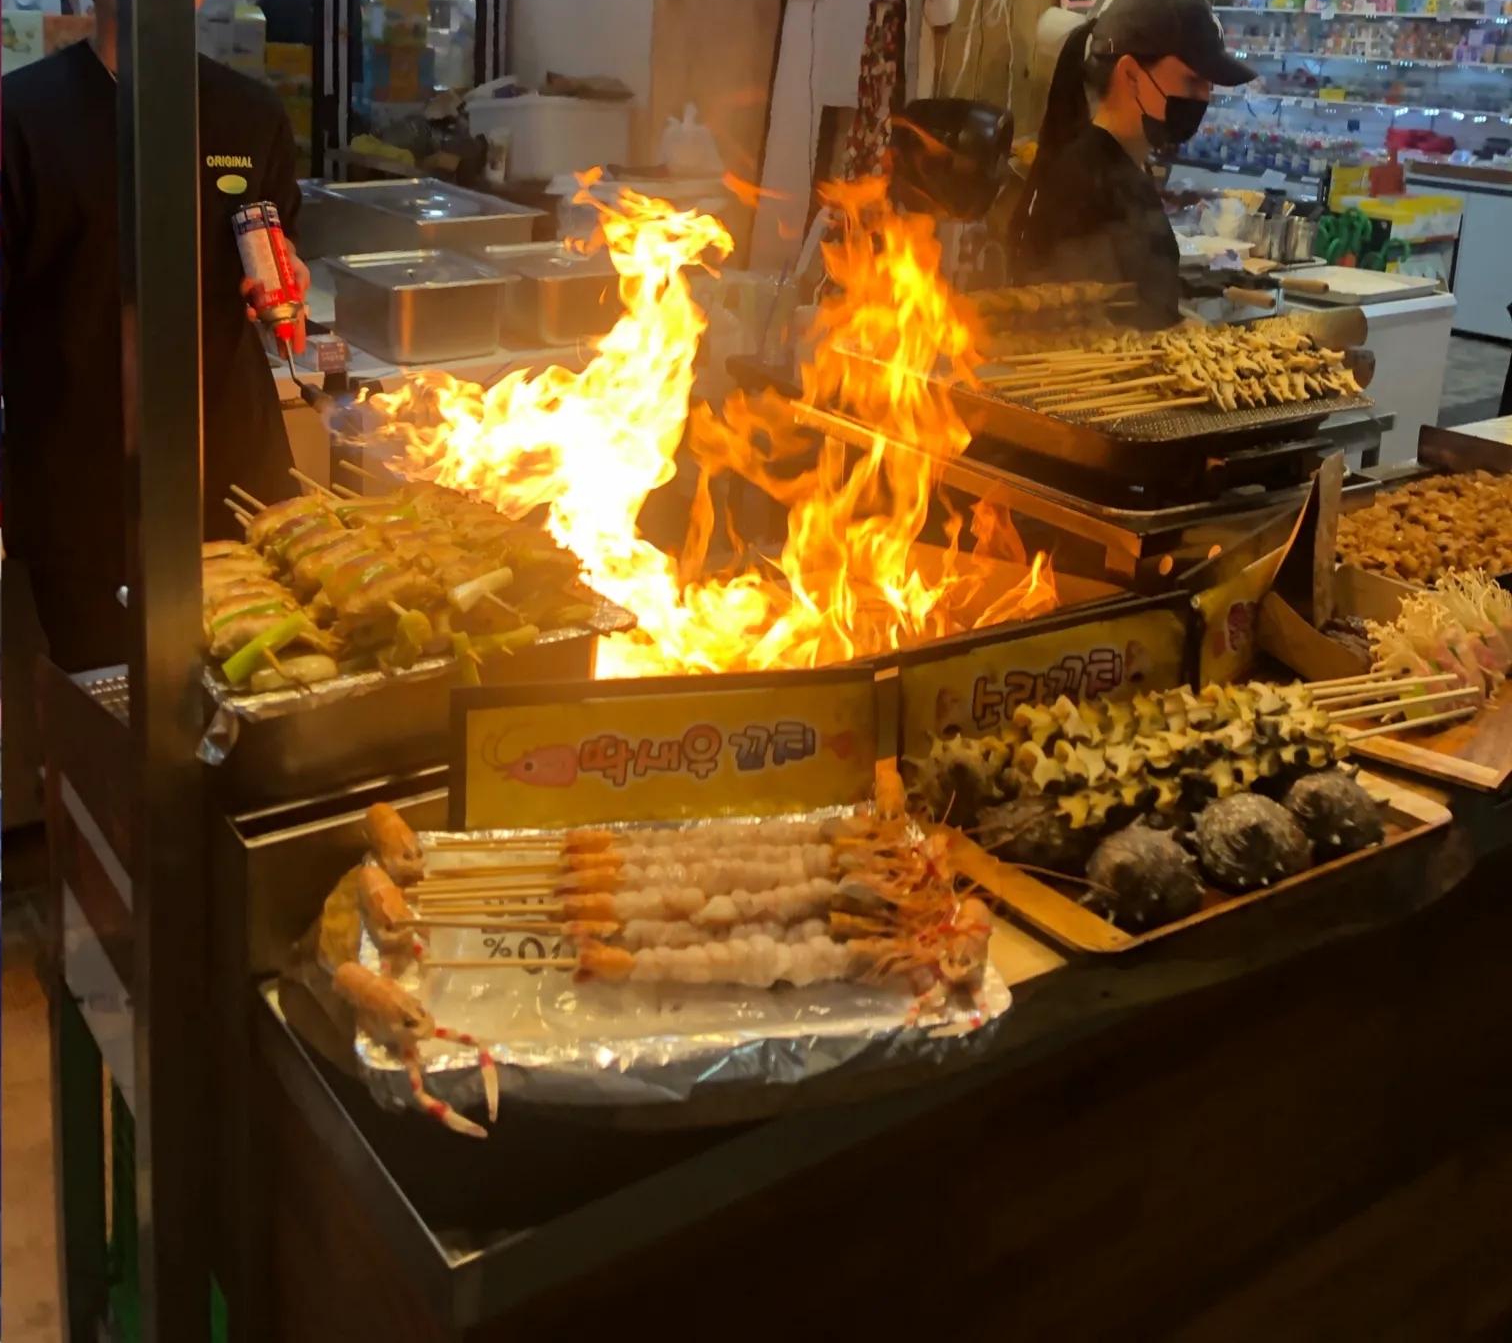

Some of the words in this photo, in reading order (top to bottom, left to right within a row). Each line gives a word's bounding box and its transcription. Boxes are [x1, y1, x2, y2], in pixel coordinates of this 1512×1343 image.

[206, 155, 253, 169] ORIGINAL
[578, 722, 723, 787] 딱새우
[729, 720, 816, 772] 꼬치
